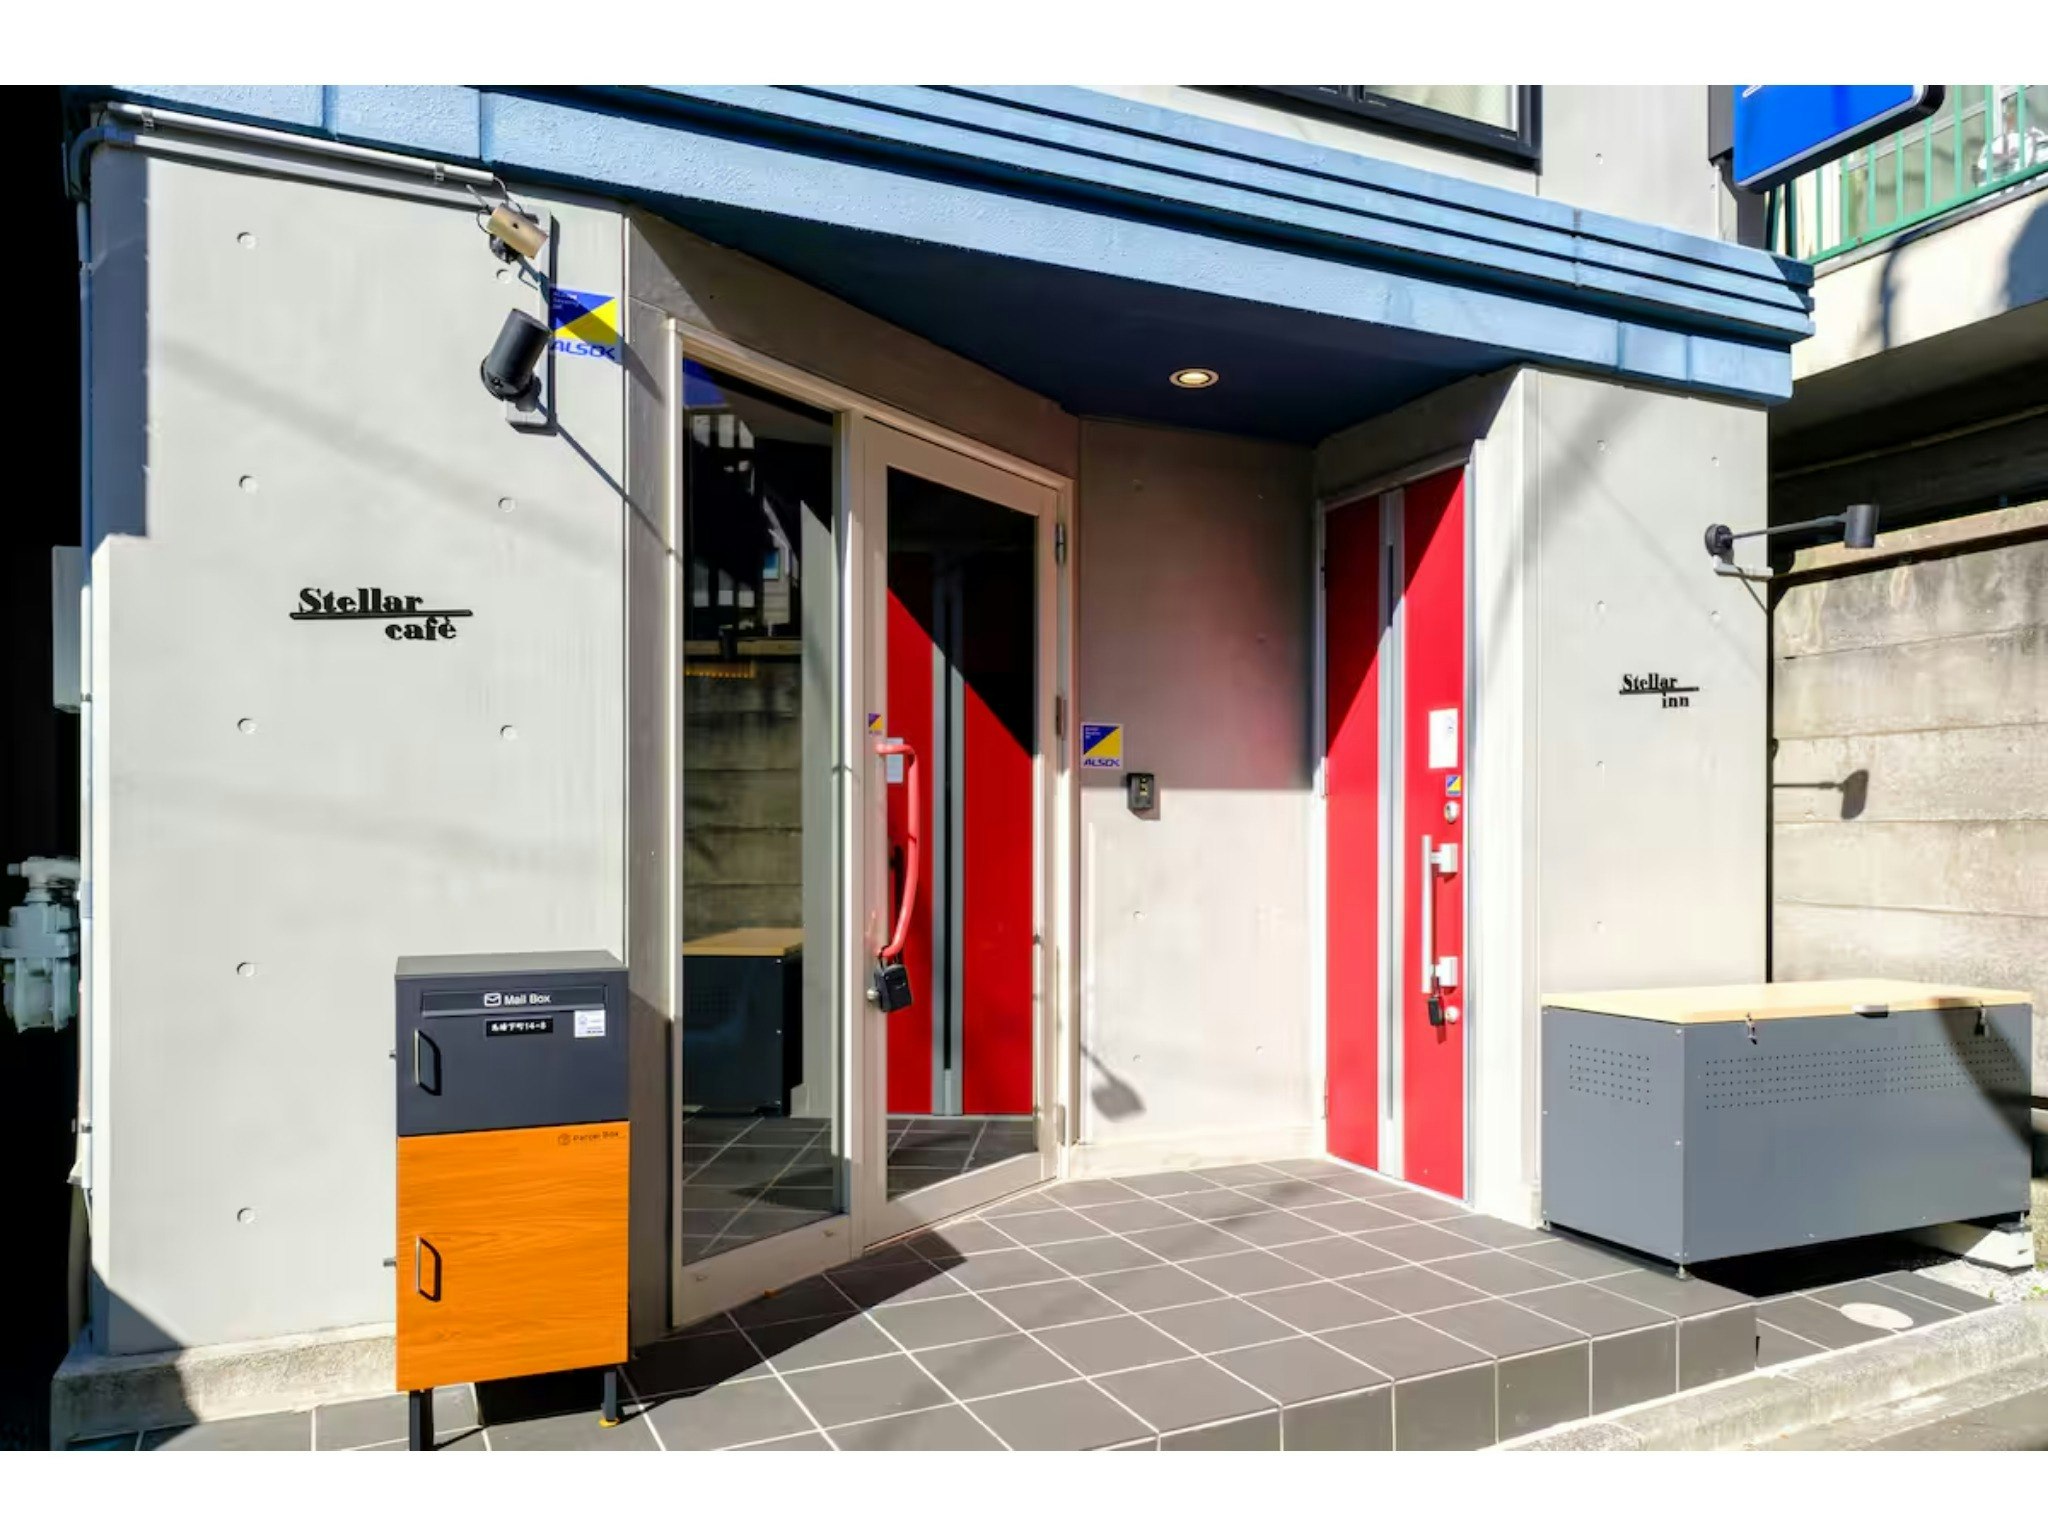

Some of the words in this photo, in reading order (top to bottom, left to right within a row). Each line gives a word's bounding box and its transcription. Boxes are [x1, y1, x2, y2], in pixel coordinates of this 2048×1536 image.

[299, 587, 424, 613] Stellar
[1622, 672, 1678, 691] Stellar
[1662, 692, 1689, 708] inn
[1084, 758, 1120, 767] ALSOK
[504, 993, 527, 1005] Mail
[529, 993, 552, 1004] Box
